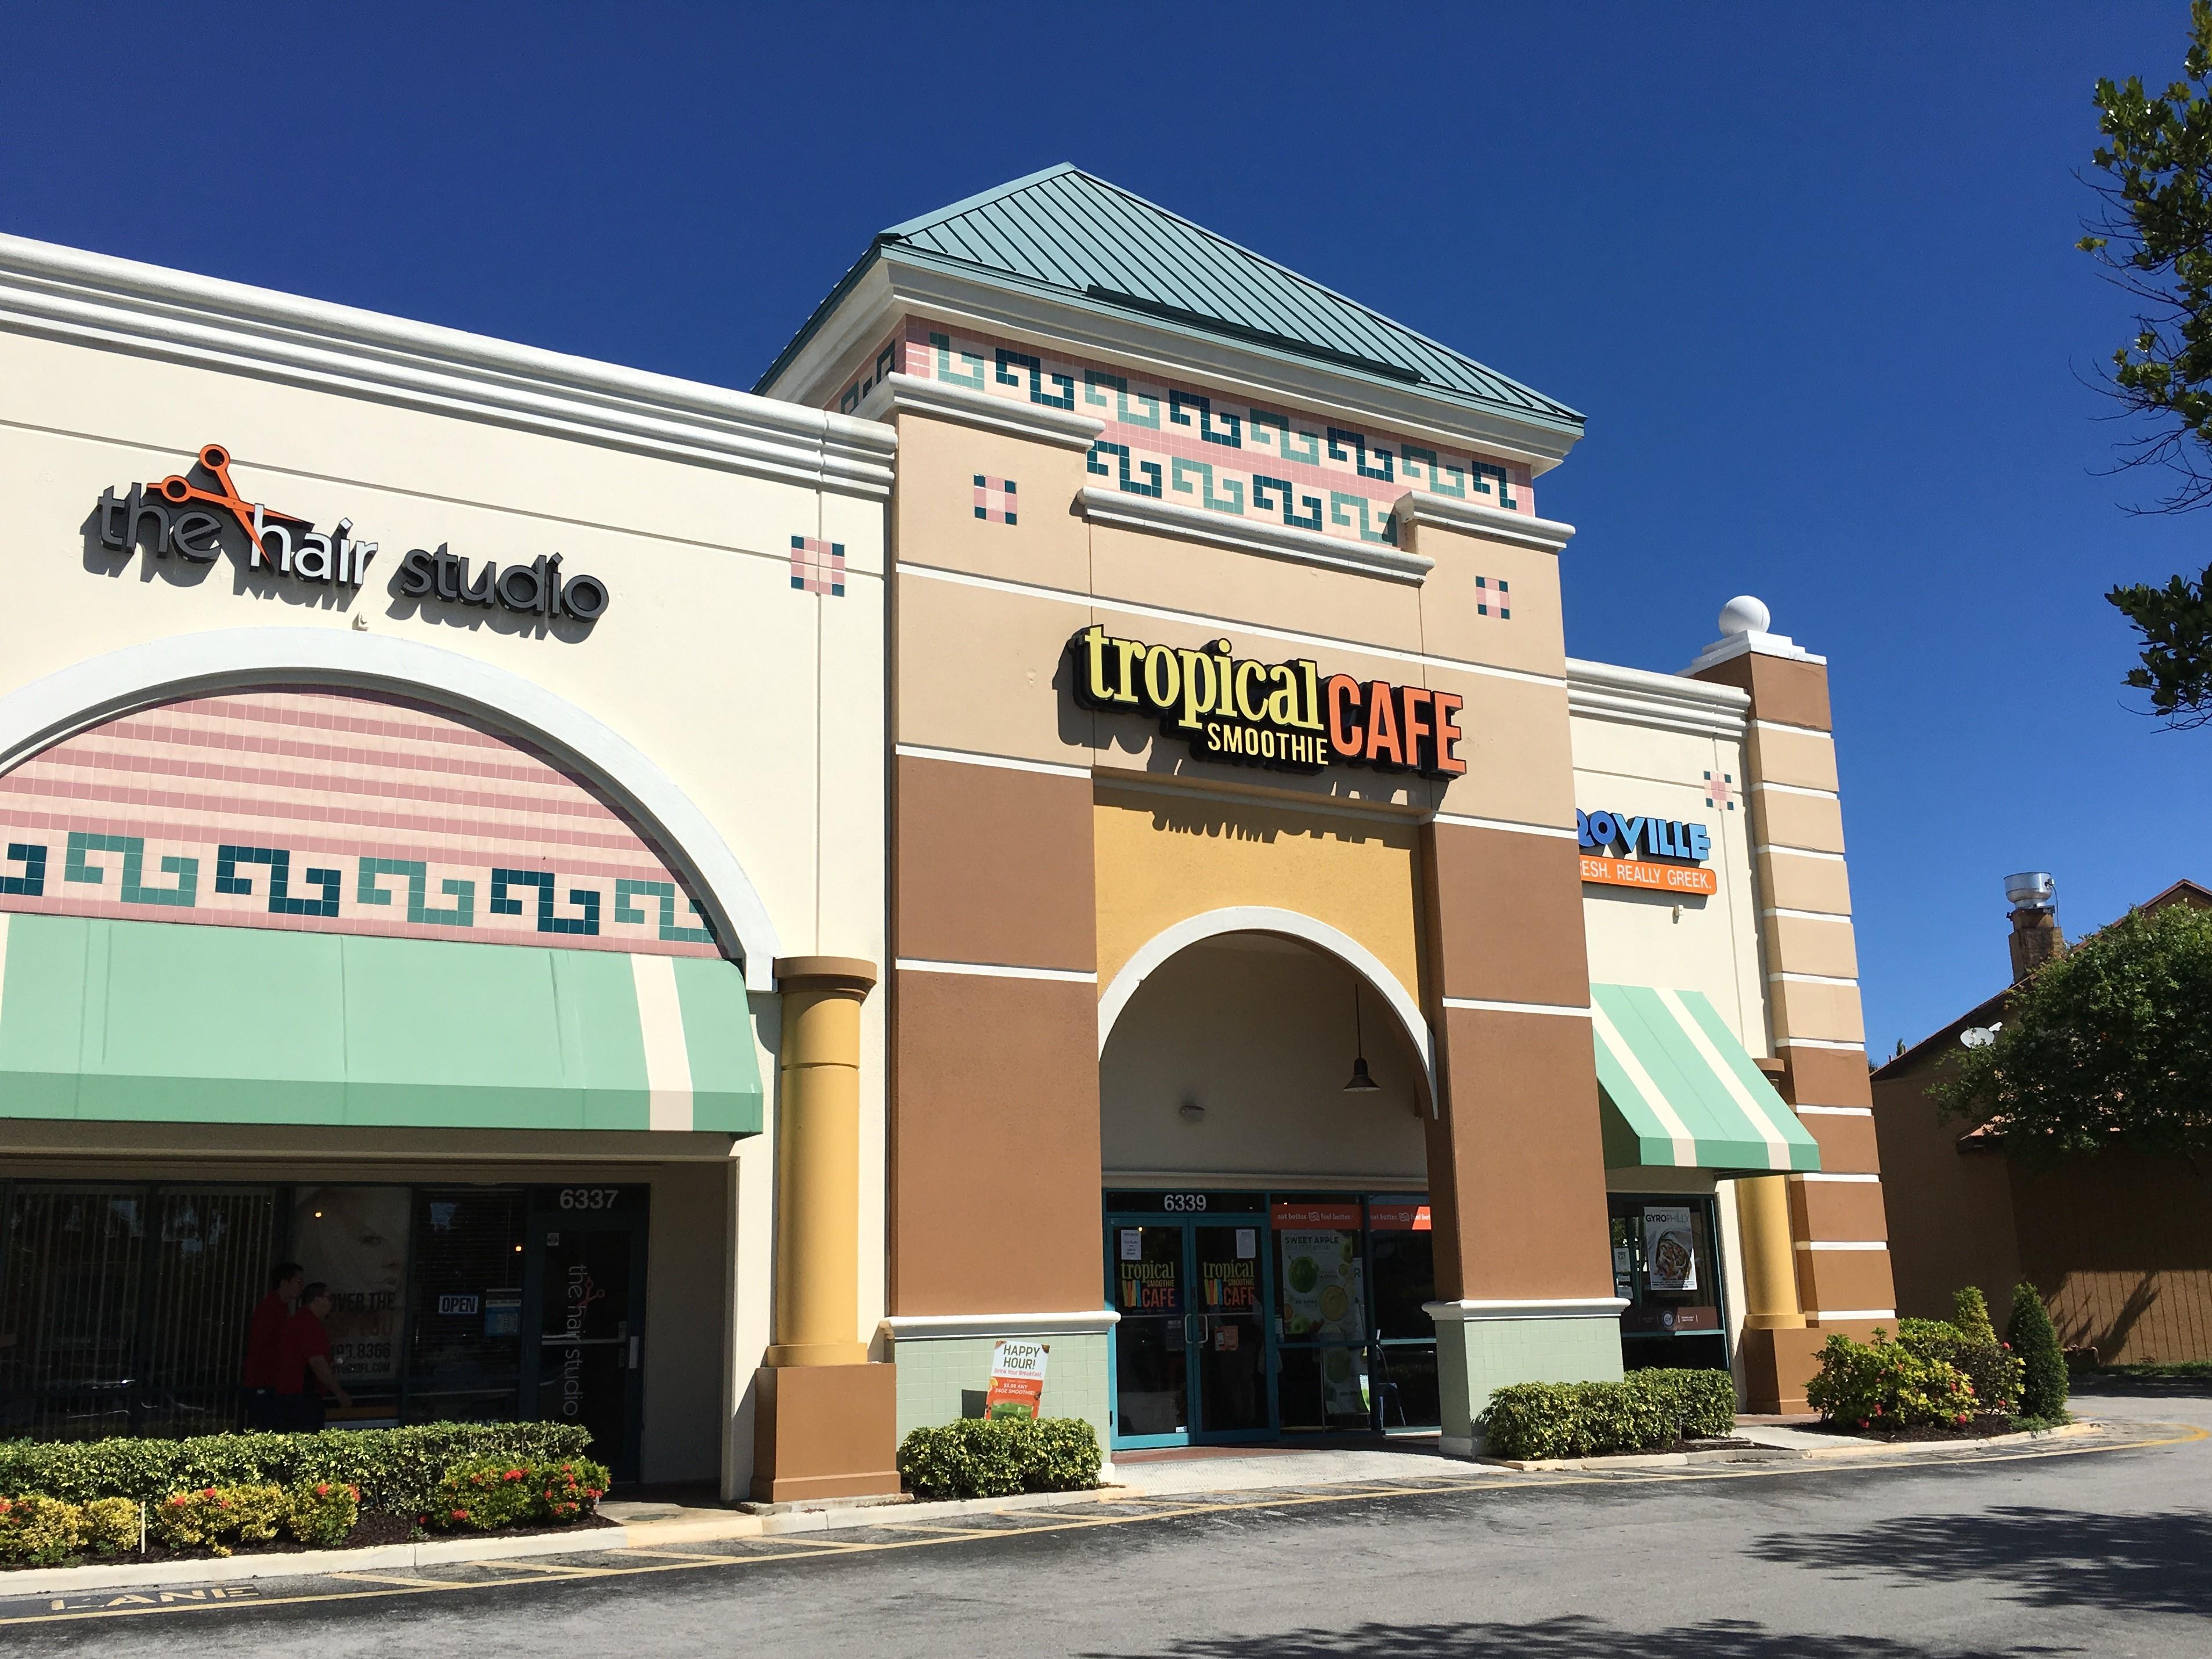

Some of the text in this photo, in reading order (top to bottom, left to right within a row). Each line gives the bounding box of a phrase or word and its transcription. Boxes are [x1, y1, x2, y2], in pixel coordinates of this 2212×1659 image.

[98, 482, 609, 622] the hair studio
[1085, 624, 1467, 775] tropical CAFE
[1208, 723, 1329, 765] SMOOTHIE
[1617, 864, 1661, 884] REALLY
[1667, 869, 1712, 890] GREEK.
[559, 1190, 619, 1210] 6337
[1163, 1194, 1207, 1212] 6339
[1285, 1236, 1339, 1244] SWEET APPLE
[568, 1264, 588, 1298] the
[1121, 1260, 1176, 1283] tropical
[1203, 1259, 1255, 1282] tropical
[442, 1296, 476, 1313] OPEN
[1142, 1288, 1176, 1307] CAFE
[1223, 1286, 1255, 1306] CAFE
[566, 1306, 587, 1342] hair
[1003, 1344, 1040, 1358] HAPPY
[1003, 1357, 1036, 1370] HOUR!
[1019, 1369, 1042, 1378] Breakfast
[563, 1349, 583, 1416] studio
[50, 1584, 259, 1610] LANE
